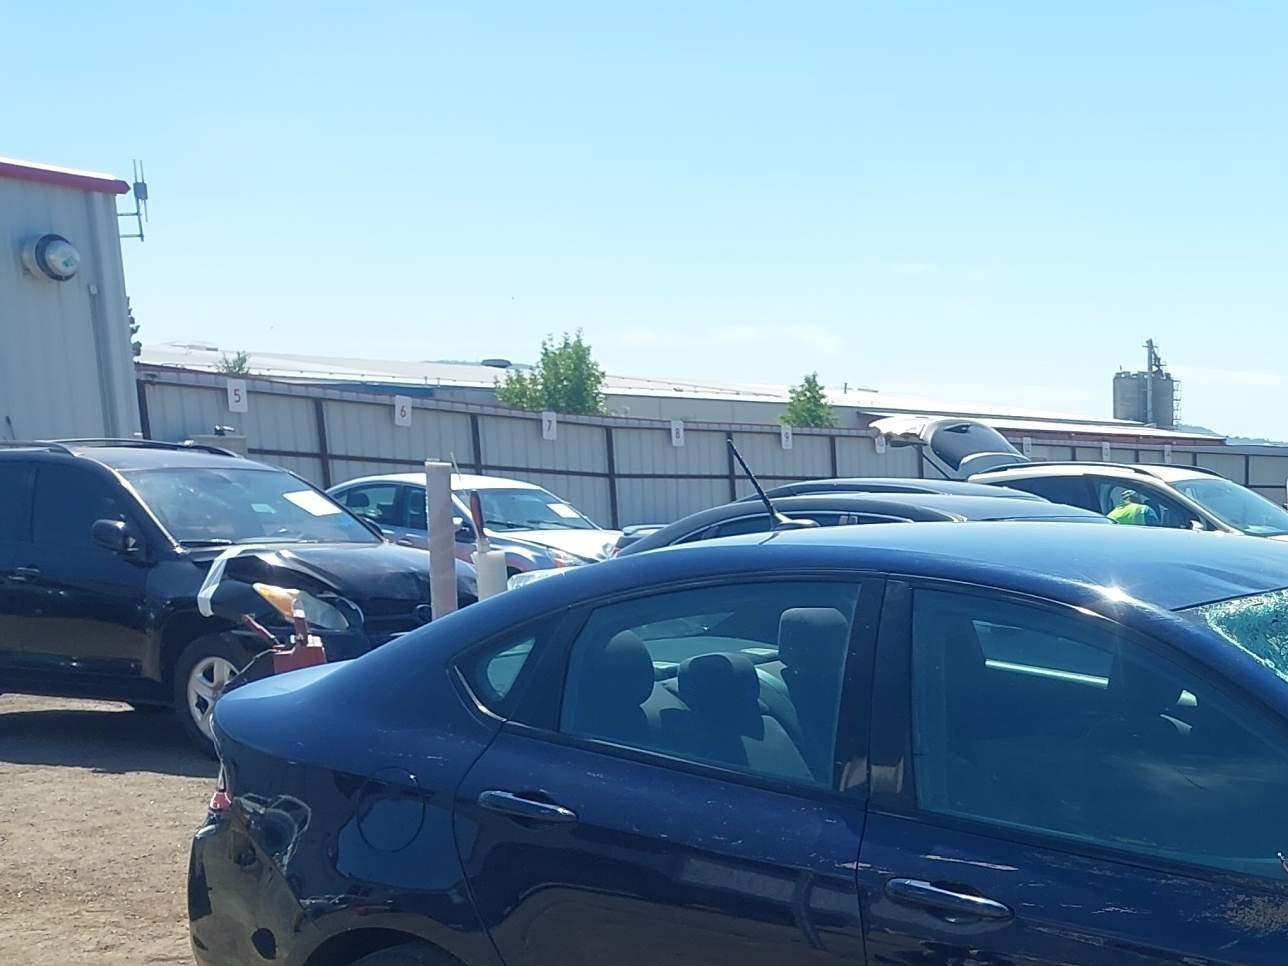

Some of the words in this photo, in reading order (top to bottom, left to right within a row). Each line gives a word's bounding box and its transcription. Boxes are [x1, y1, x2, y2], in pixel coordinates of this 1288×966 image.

[233, 388, 241, 403] 5
[399, 403, 407, 418] 6
[546, 419, 554, 432] 7
